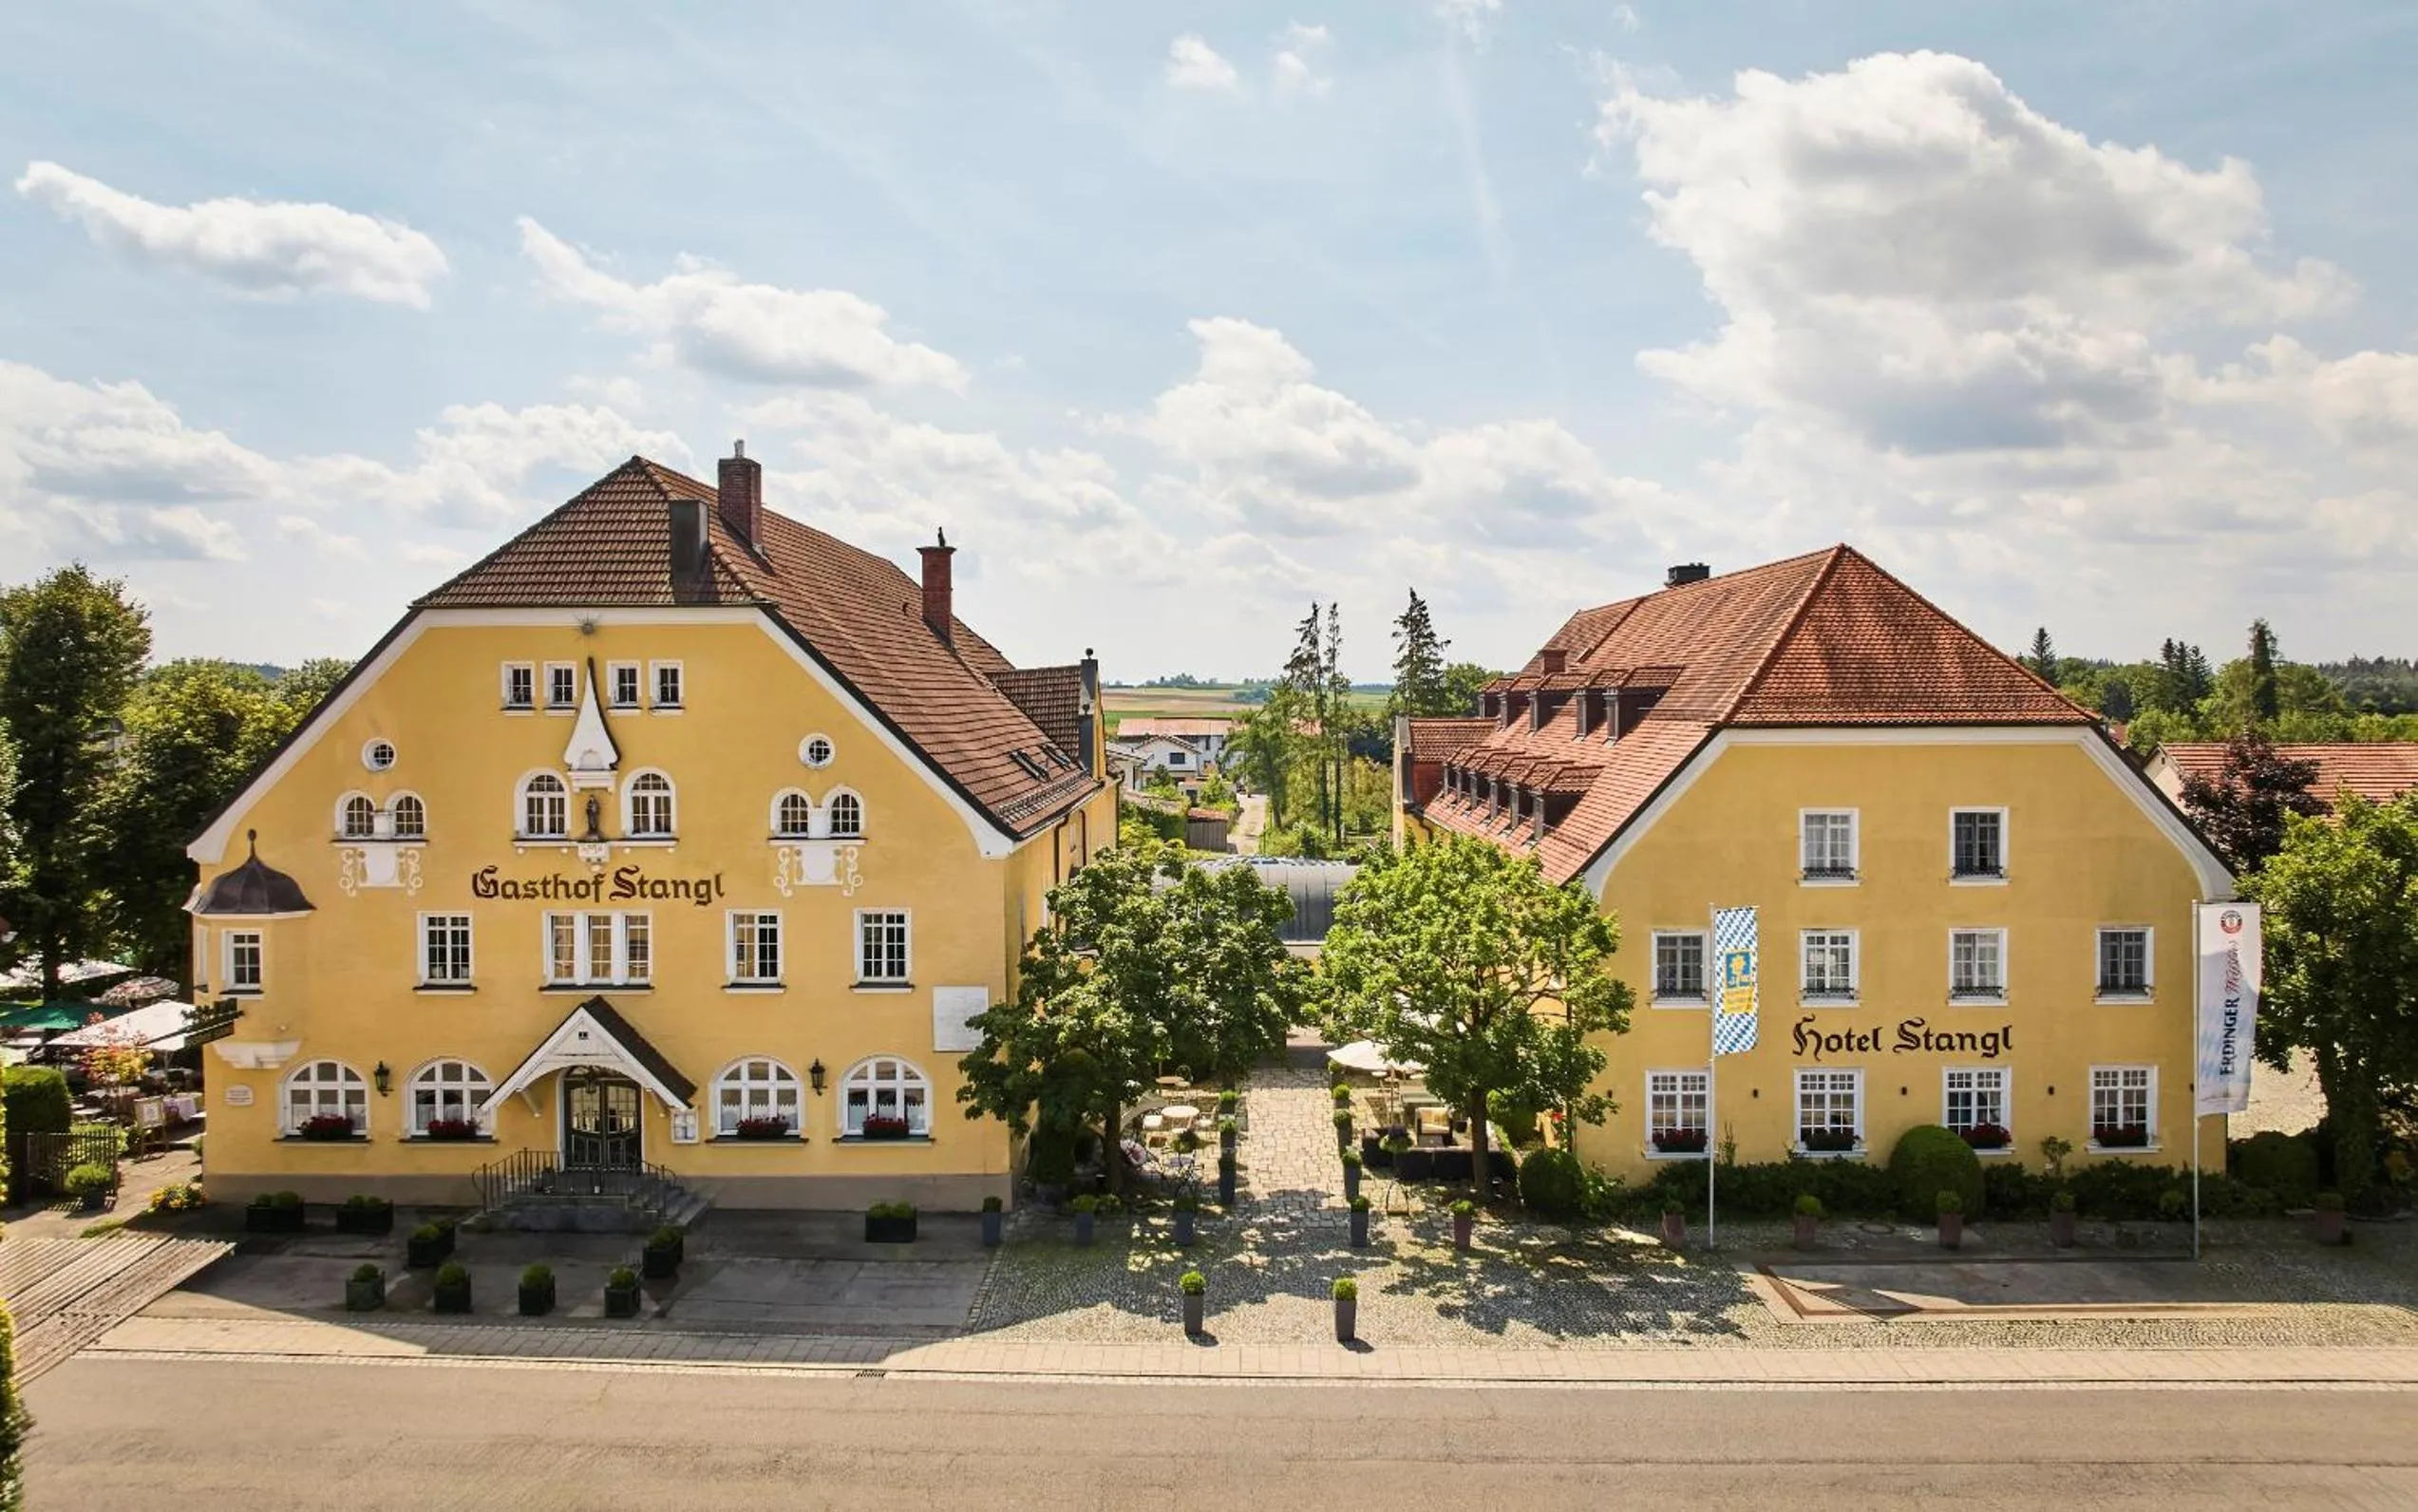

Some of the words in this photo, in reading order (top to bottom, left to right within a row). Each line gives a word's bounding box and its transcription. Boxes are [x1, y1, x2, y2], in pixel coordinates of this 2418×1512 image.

[472, 865, 606, 902] Gasthof
[609, 865, 726, 906] Stangl
[1792, 1013, 1883, 1062] Hotel
[1893, 1016, 2012, 1058] Stangl
[2220, 997, 2240, 1076] ERDINGER
